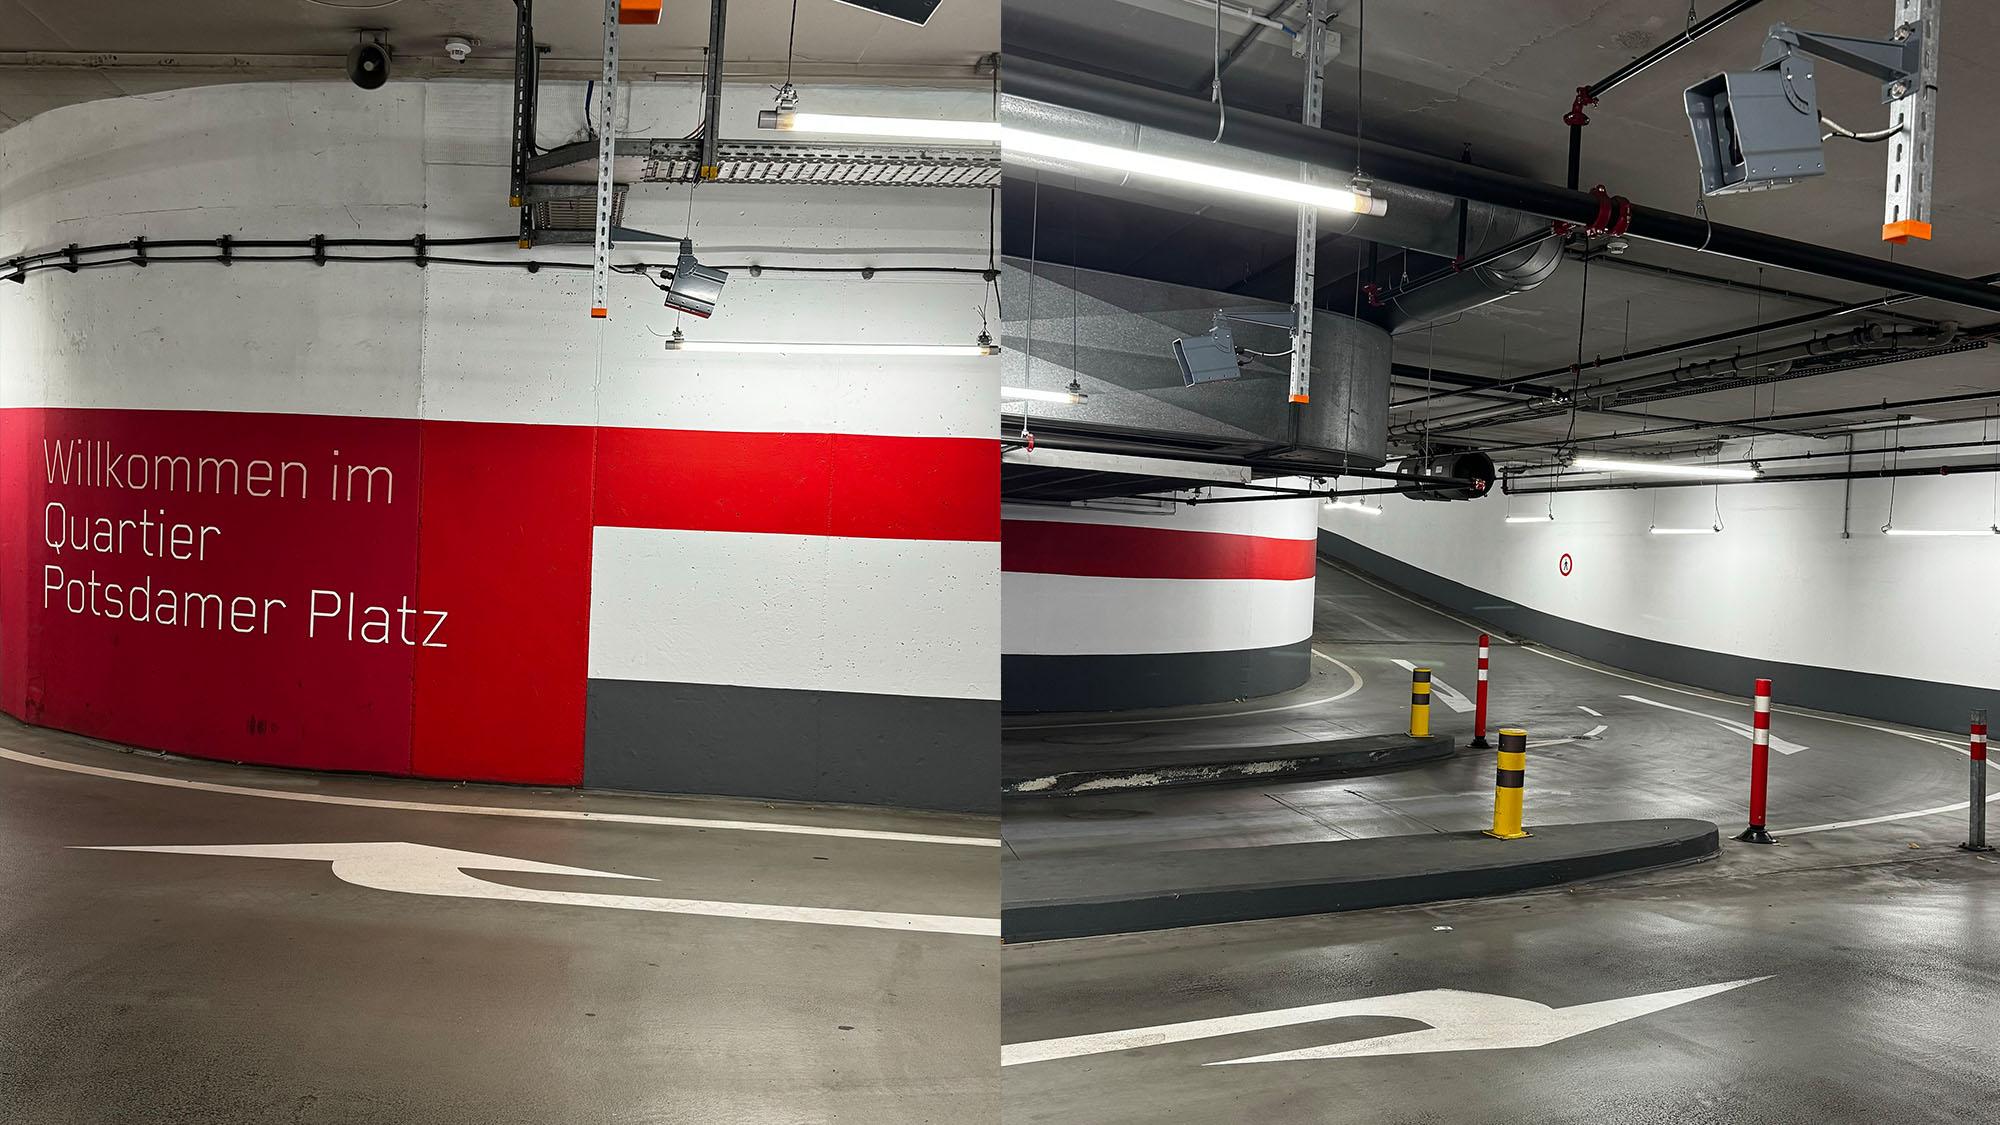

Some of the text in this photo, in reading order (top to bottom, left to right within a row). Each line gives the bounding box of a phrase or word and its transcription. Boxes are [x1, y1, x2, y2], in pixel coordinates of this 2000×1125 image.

[43, 439, 393, 503] Willkommen im
[44, 502, 221, 561] Quartier
[44, 564, 449, 648] Potsdamer Platz
